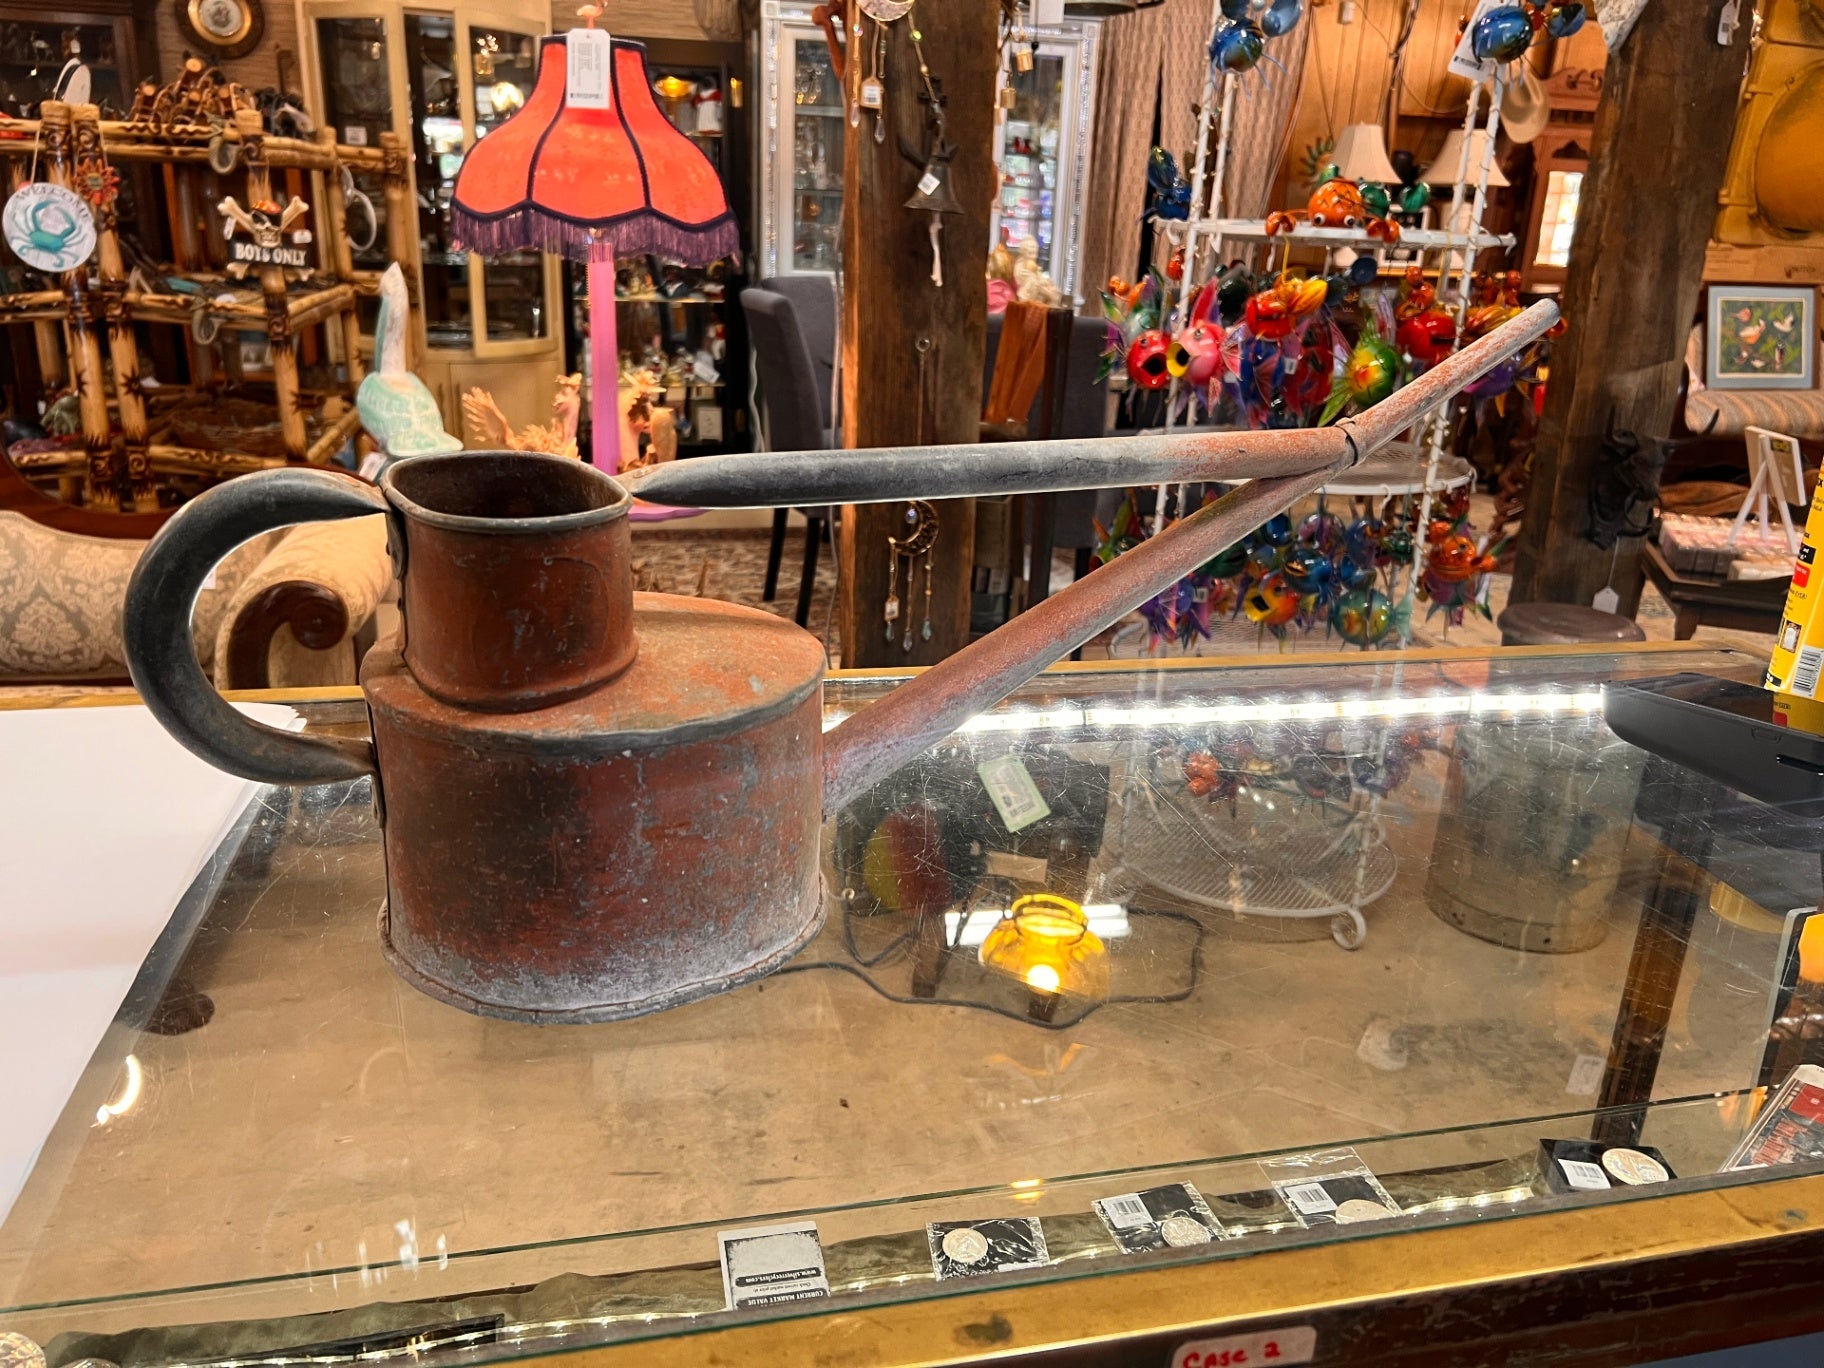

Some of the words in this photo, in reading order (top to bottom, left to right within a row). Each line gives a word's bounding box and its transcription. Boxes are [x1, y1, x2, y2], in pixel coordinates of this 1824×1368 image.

[234, 242, 270, 262] BOYS
[272, 247, 307, 267] ONLY
[769, 1294, 795, 1303] MARKET
[796, 1290, 823, 1300] CURRENT
[747, 1297, 768, 1306] VALUE
[1264, 1341, 1280, 1358] 2
